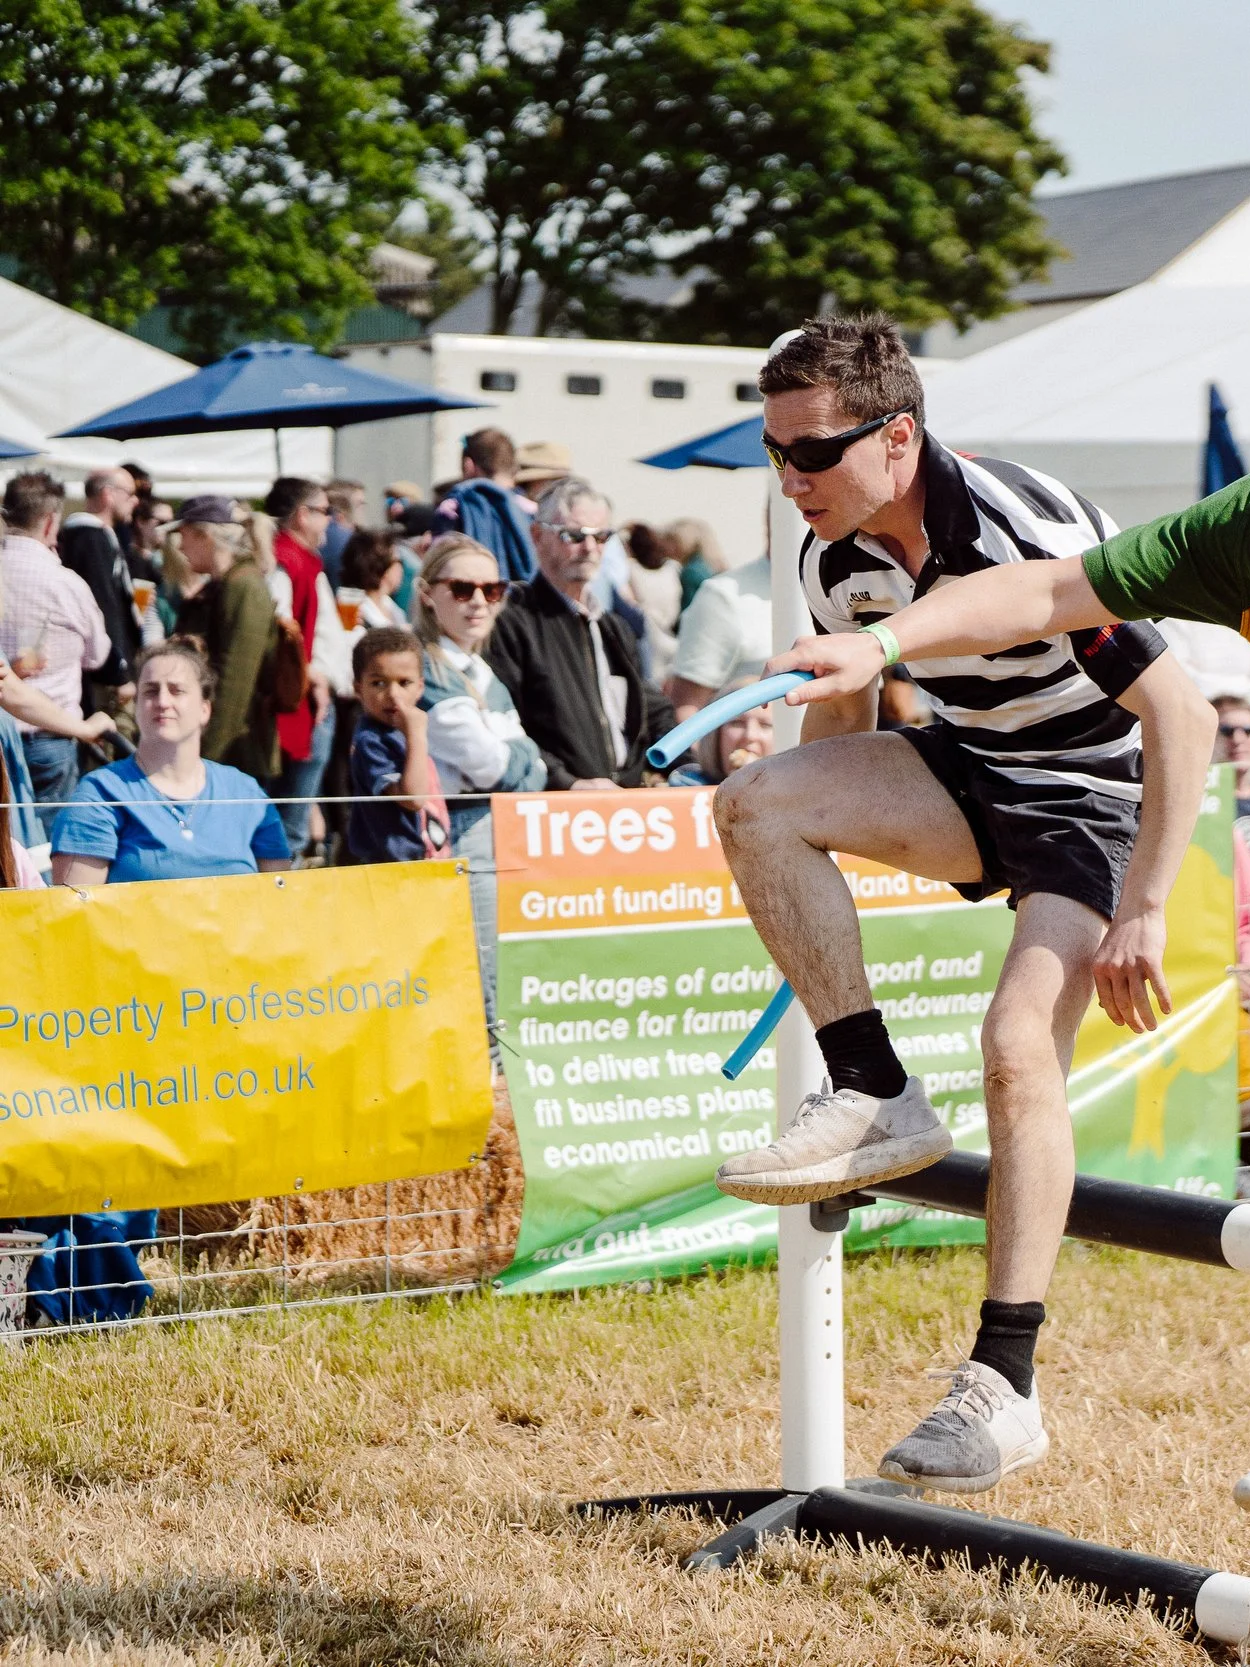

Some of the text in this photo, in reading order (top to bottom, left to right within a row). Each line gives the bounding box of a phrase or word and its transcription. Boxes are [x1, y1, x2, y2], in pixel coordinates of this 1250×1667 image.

[516, 799, 676, 858] Trees
[520, 888, 605, 920] Grant
[612, 882, 723, 916] funding
[844, 872, 910, 897] land
[521, 971, 669, 1006] Packages
[674, 967, 705, 997] of
[711, 964, 775, 994] advi
[929, 951, 984, 980] and
[0, 969, 431, 1049] Property Professionals
[518, 1013, 629, 1046] finance
[636, 1009, 677, 1038] for
[682, 1007, 766, 1036] farme
[0, 1053, 316, 1122] sonandhall.co.uk
[525, 1056, 554, 1088] to
[562, 1051, 661, 1085] deliver
[665, 1049, 724, 1076] tree
[534, 1098, 563, 1128] fit
[567, 1091, 692, 1125] business
[697, 1086, 775, 1121] plans
[543, 1128, 711, 1169] economical
[717, 1121, 773, 1154] and
[594, 1221, 651, 1255] out
